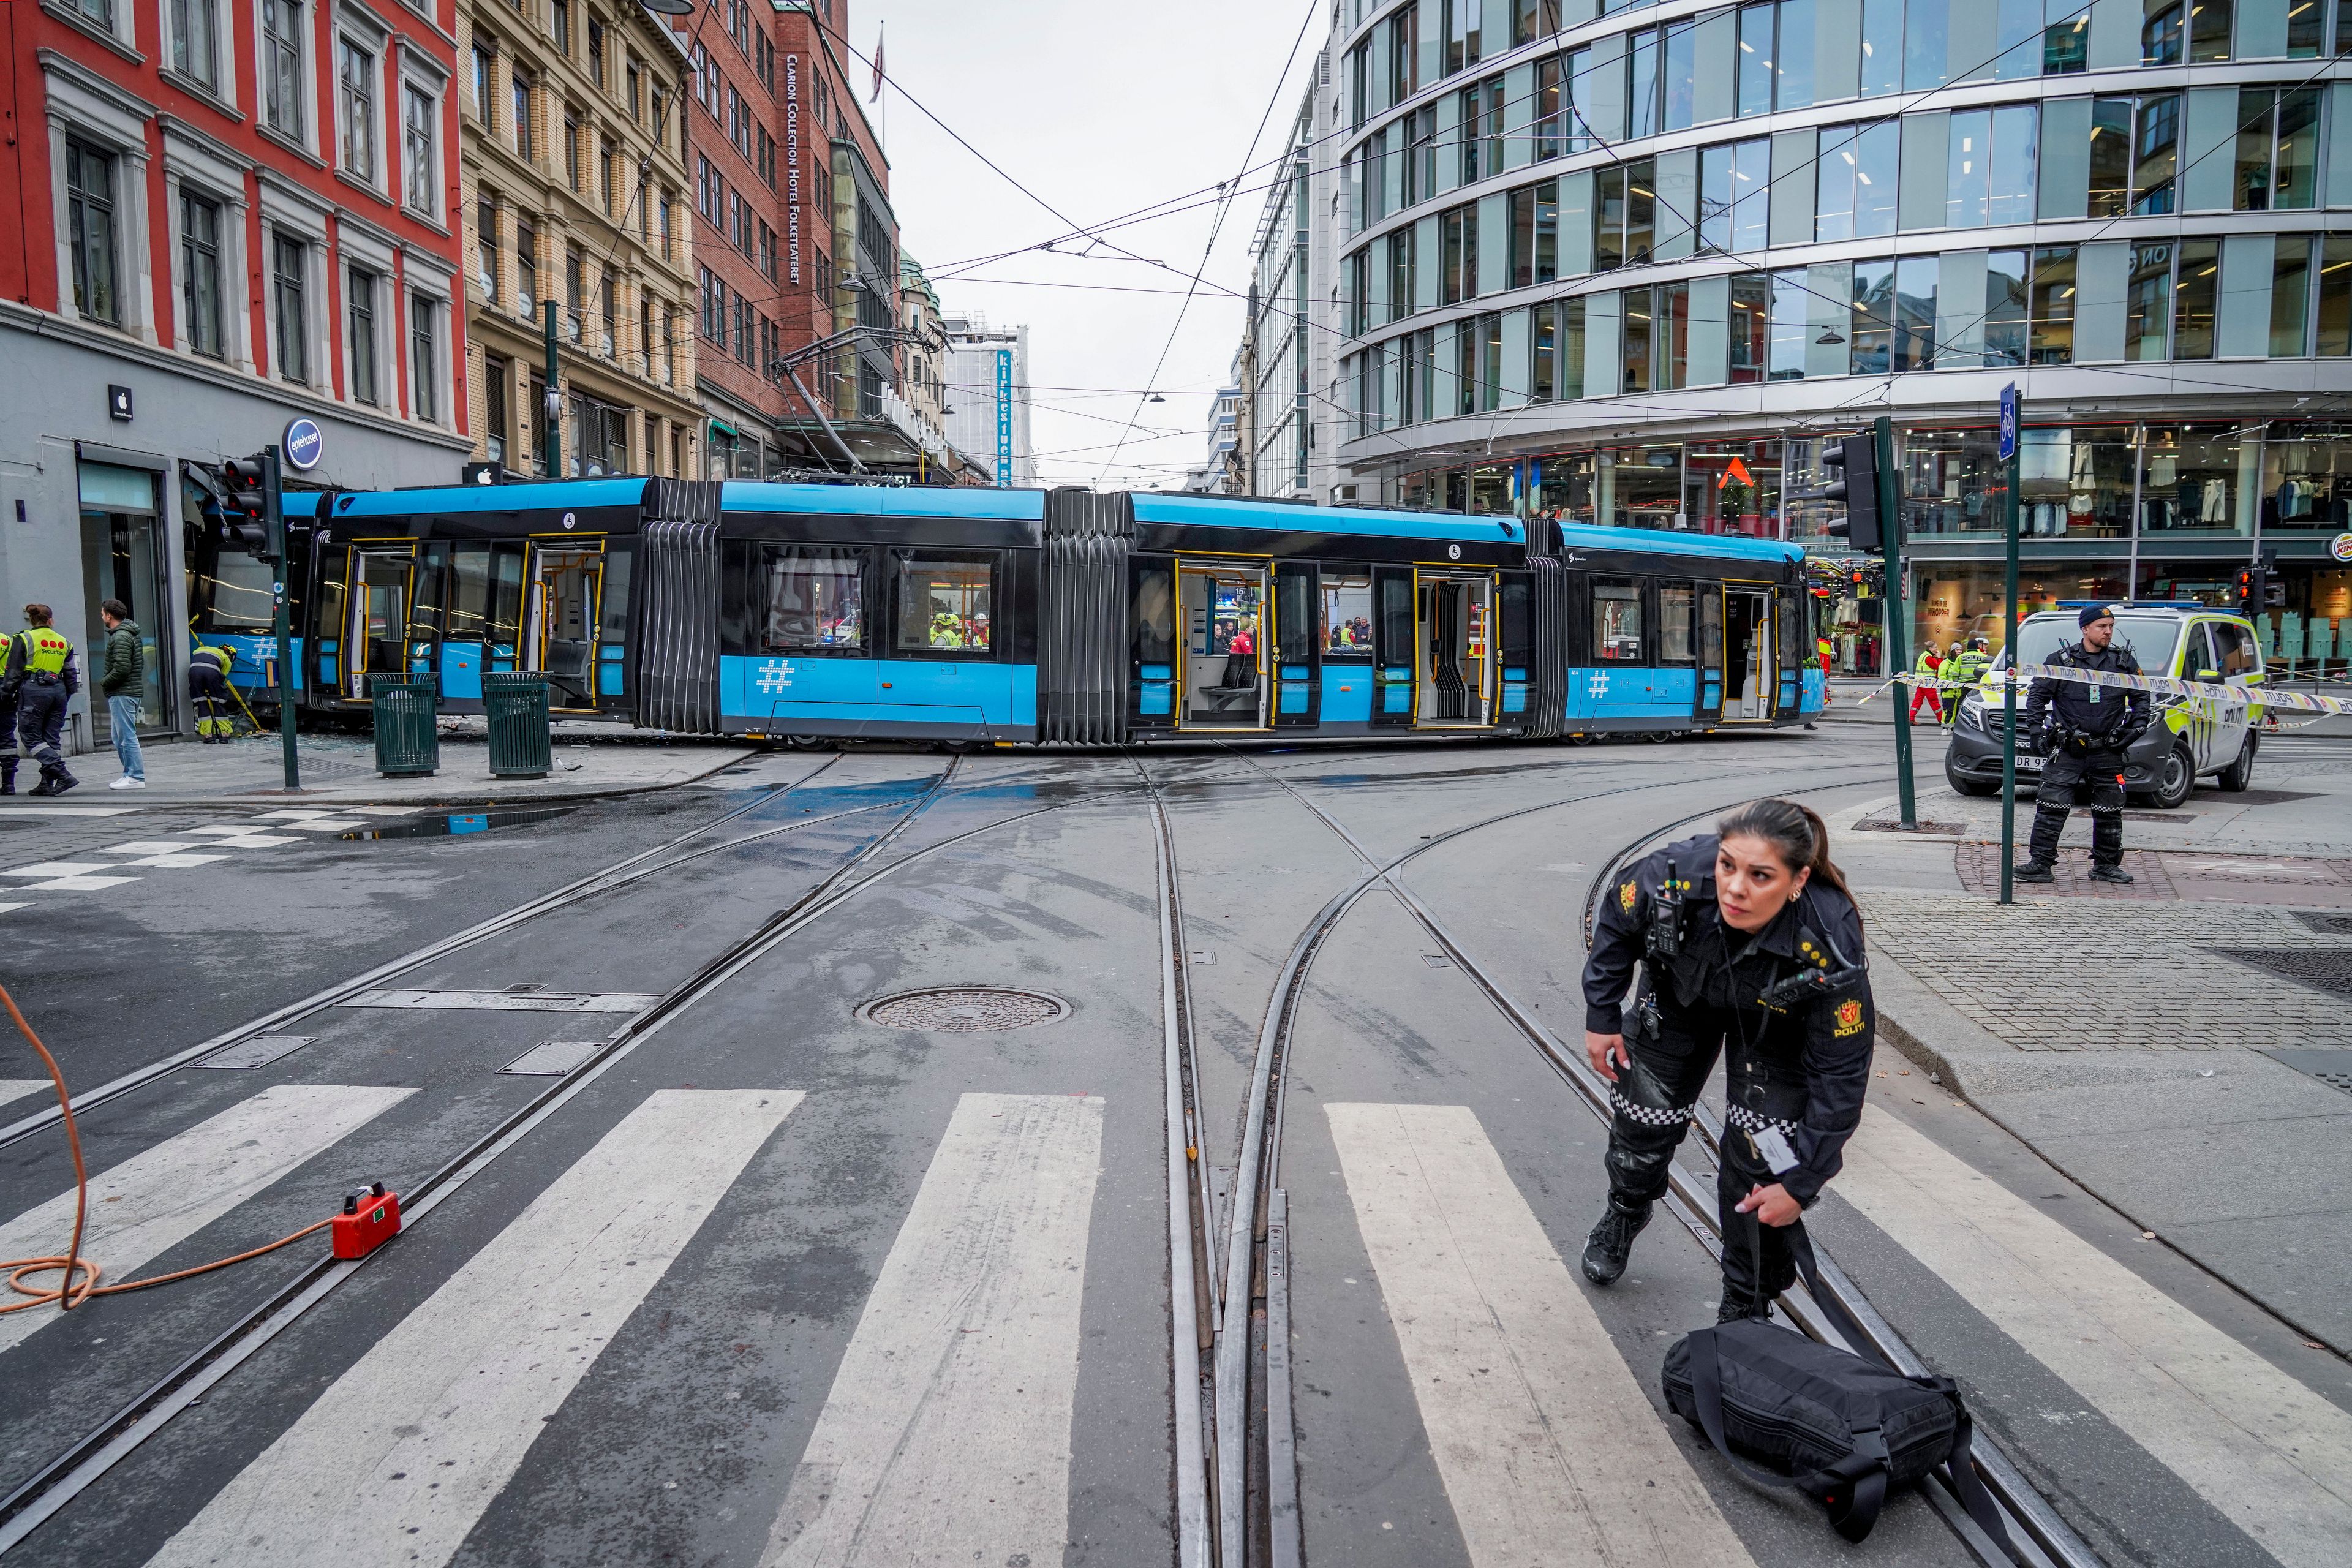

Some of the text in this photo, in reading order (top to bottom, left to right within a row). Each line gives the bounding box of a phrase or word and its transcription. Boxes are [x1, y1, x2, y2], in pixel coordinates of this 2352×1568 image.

[786, 54, 800, 285] CLARION COLLECTION HOTEL FOLKETEATERET
[291, 431, 318, 453] eplehuset
[2337, 538, 2352, 548] BURG
[1928, 607, 1950, 617] WHOPPER
[2225, 707, 2244, 725] POLITI
[2016, 757, 2030, 767] DR
[1834, 1021, 1866, 1038] POLITI
